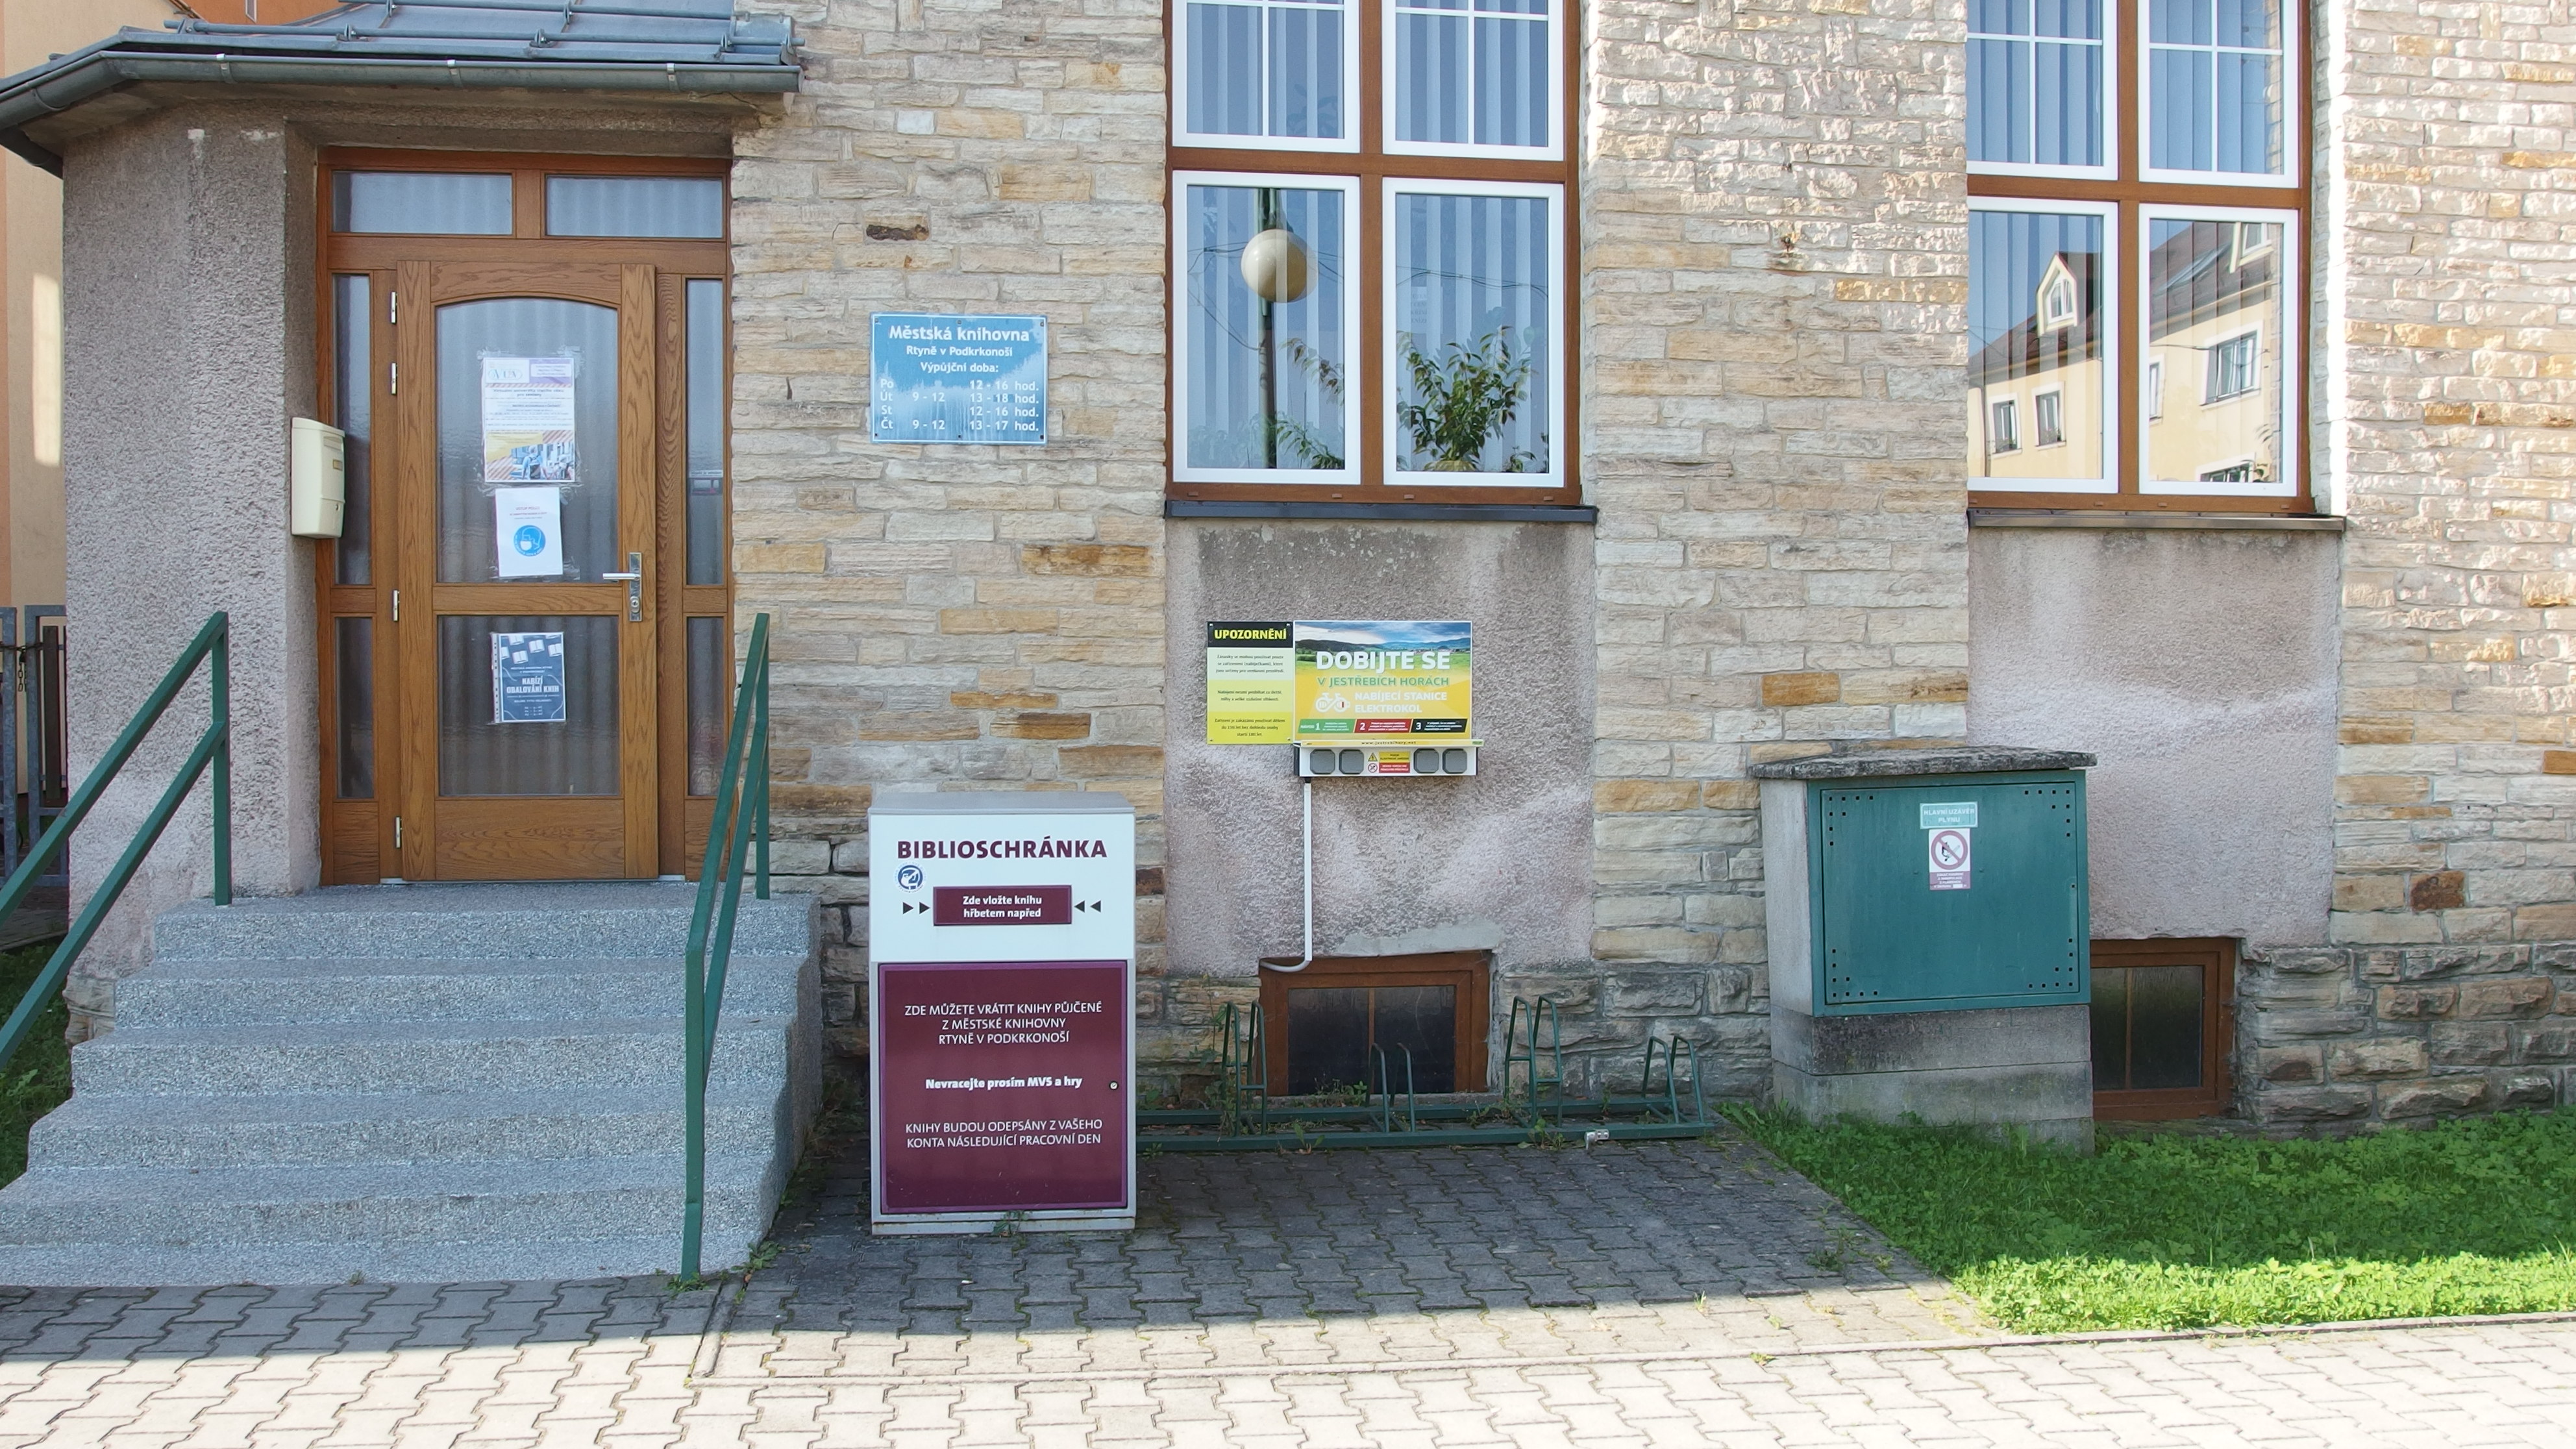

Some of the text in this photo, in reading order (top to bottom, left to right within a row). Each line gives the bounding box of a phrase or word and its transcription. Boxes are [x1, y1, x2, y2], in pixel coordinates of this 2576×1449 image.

[889, 326, 1029, 341] Městská knihovna
[907, 345, 937, 357] Rtyně
[950, 347, 1013, 356] Podkrkonoší
[921, 362, 998, 373] Výpůjční doba:
[880, 378, 894, 388] Po
[970, 380, 983, 390] 12
[995, 380, 1008, 390] 16
[1015, 381, 1039, 391] hod.
[880, 390, 893, 402] Út
[913, 392, 919, 401] 9
[932, 393, 945, 402] 12
[971, 393, 983, 402] 13
[995, 393, 1008, 402] 18
[1015, 394, 1039, 404] hod.
[881, 405, 892, 415] St
[970, 406, 983, 416] 12
[995, 406, 1008, 416] 16
[1015, 407, 1039, 417] hod.
[881, 417, 893, 429] Čt
[913, 420, 919, 429] 9
[932, 420, 945, 430] 12
[970, 421, 982, 430] 13
[995, 421, 1008, 430] 17
[1015, 421, 1039, 431] hod.
[1215, 628, 1286, 639] UPOZORNĚNÍ
[1316, 651, 1451, 674] DOBIJTE SE
[522, 676, 543, 685] NABÍZÍ
[1318, 675, 1449, 689] V JESTŘEBÍCH HORÁCH
[507, 684, 542, 693] OBALOVÁNÍ
[1355, 691, 1447, 702] NABÍJECÍ STANICE
[1355, 704, 1422, 713] ELEKTROKOL
[1359, 722, 1365, 730] 2
[1415, 722, 1421, 730] 3
[897, 836, 1107, 859] BIBLIOSCHRÁNKA
[963, 895, 1042, 905] Zde vložte knihu
[964, 908, 1041, 919] hřbetem napřed
[904, 1001, 1102, 1015] ZDE MŮŽETE VRÁTIT KNIHY PŮJČENÉ
[942, 1017, 1066, 1030] Z MĚSTSKÉ KNIHOVNY
[939, 1030, 1069, 1045] RTYNĚ V PODKRKONOŠÍ
[926, 1077, 985, 1091] Nevracejte
[987, 1076, 1025, 1090] prosím
[1027, 1076, 1052, 1087] MVS
[1063, 1076, 1082, 1088] hry
[906, 1118, 1102, 1133] KNIHY BUDOU ODEPSÁNY Z VAŠEHO
[908, 1133, 1100, 1148] KONTA NÁSLEDUJÍCÍ PRACOVNÍ DEN
